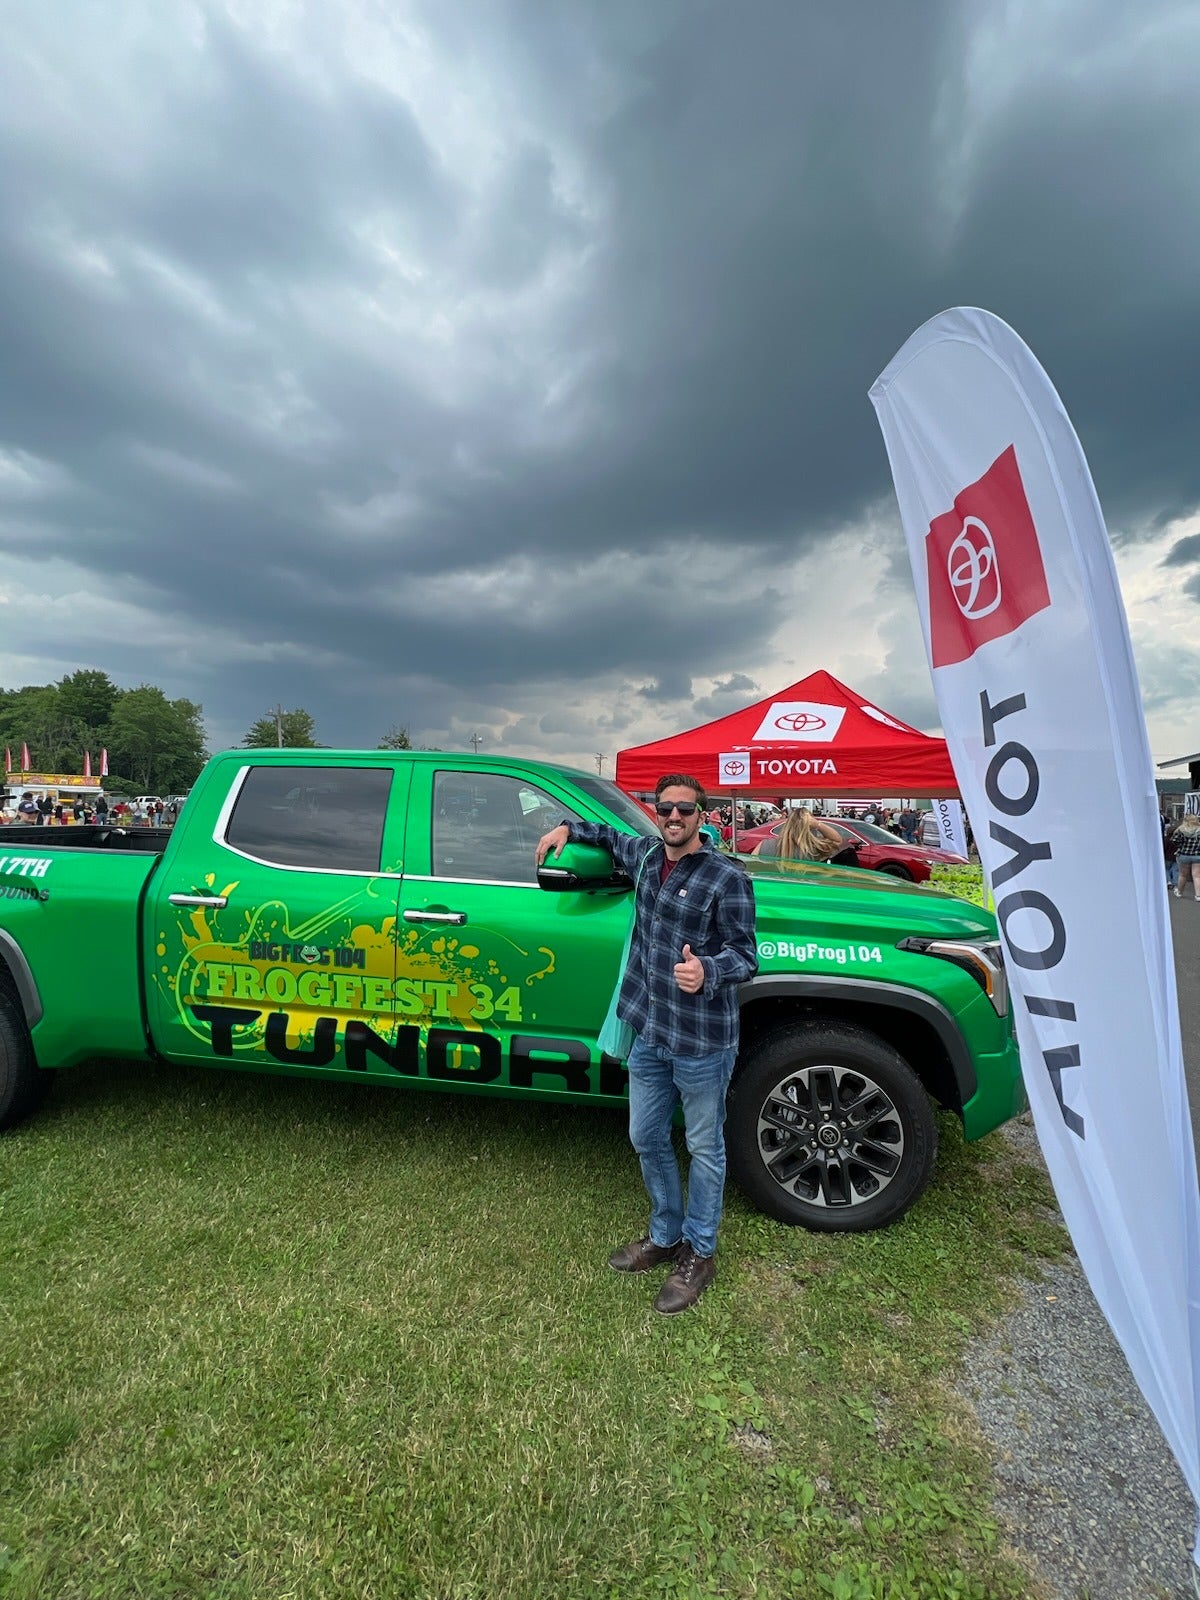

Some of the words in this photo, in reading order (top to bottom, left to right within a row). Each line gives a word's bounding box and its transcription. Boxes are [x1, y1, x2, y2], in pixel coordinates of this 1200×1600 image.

[757, 759, 838, 775] TOYOTA
[0, 856, 53, 878] 17TH
[281, 944, 331, 966] FRG
[333, 946, 366, 969] 104
[757, 941, 883, 965] @BigFrog104
[205, 962, 458, 1018] FROGFEST
[469, 983, 523, 1022] 34
